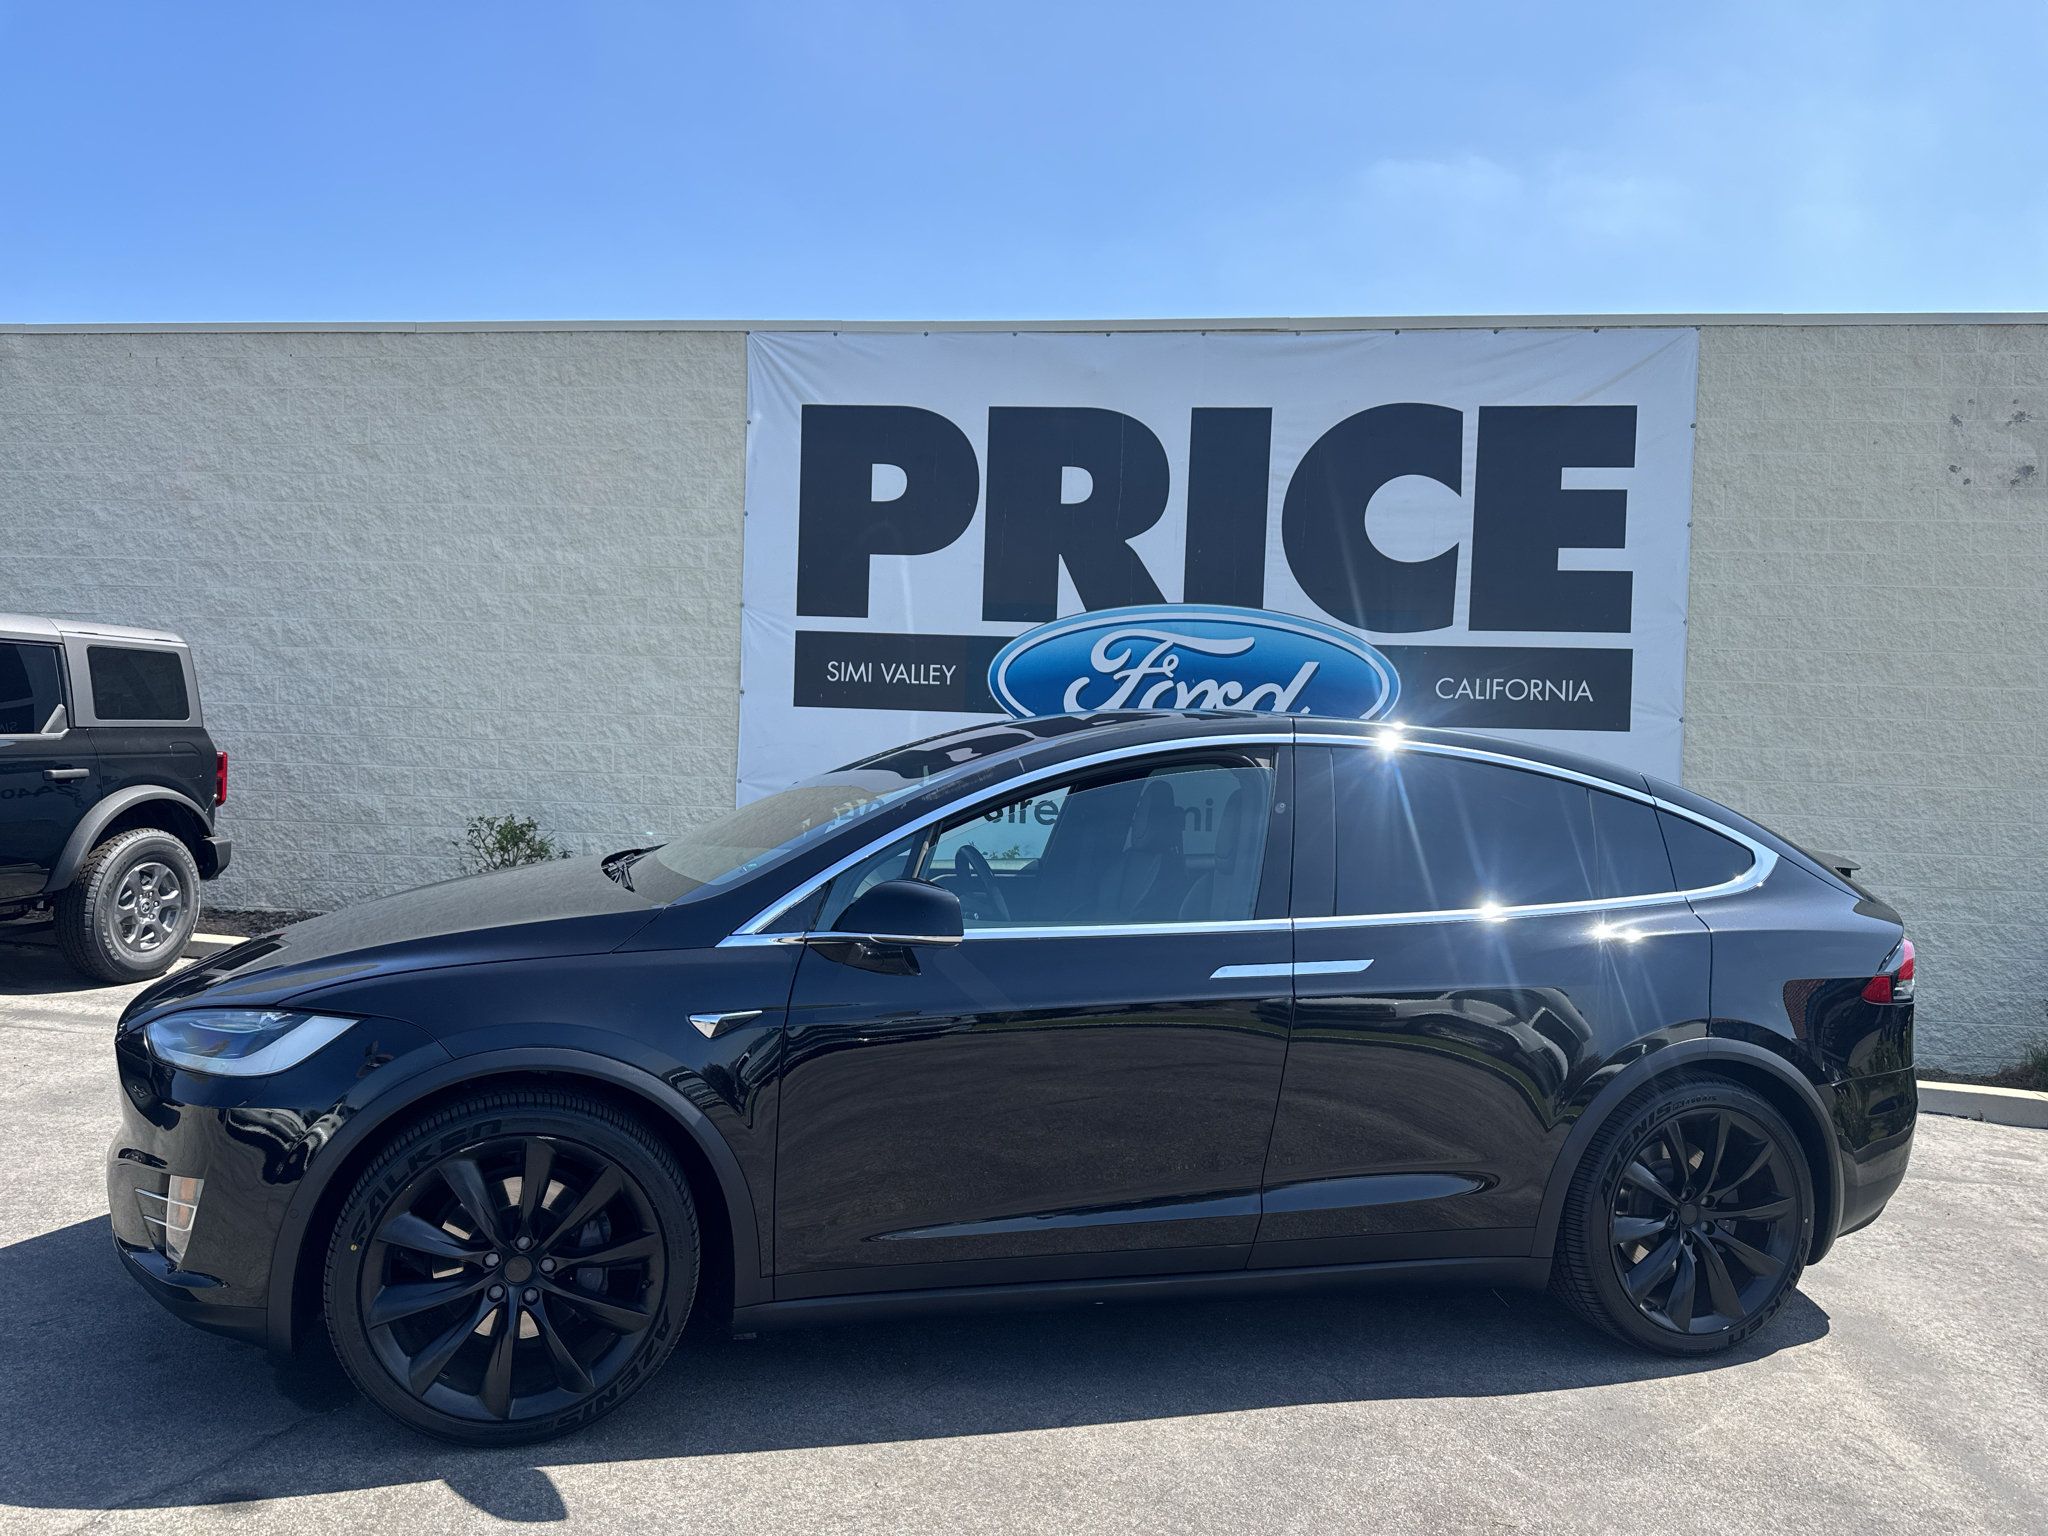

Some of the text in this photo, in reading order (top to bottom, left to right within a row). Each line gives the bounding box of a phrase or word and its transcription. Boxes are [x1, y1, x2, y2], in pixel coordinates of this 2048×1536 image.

[797, 402, 1637, 632] PRICE
[826, 661, 957, 685] SIMI VALLEY
[1063, 629, 1320, 713] Ford
[1435, 677, 1594, 702] CALIFORNIA
[1600, 1100, 1672, 1208] AZENIS
[555, 1303, 673, 1430] AZENIS
